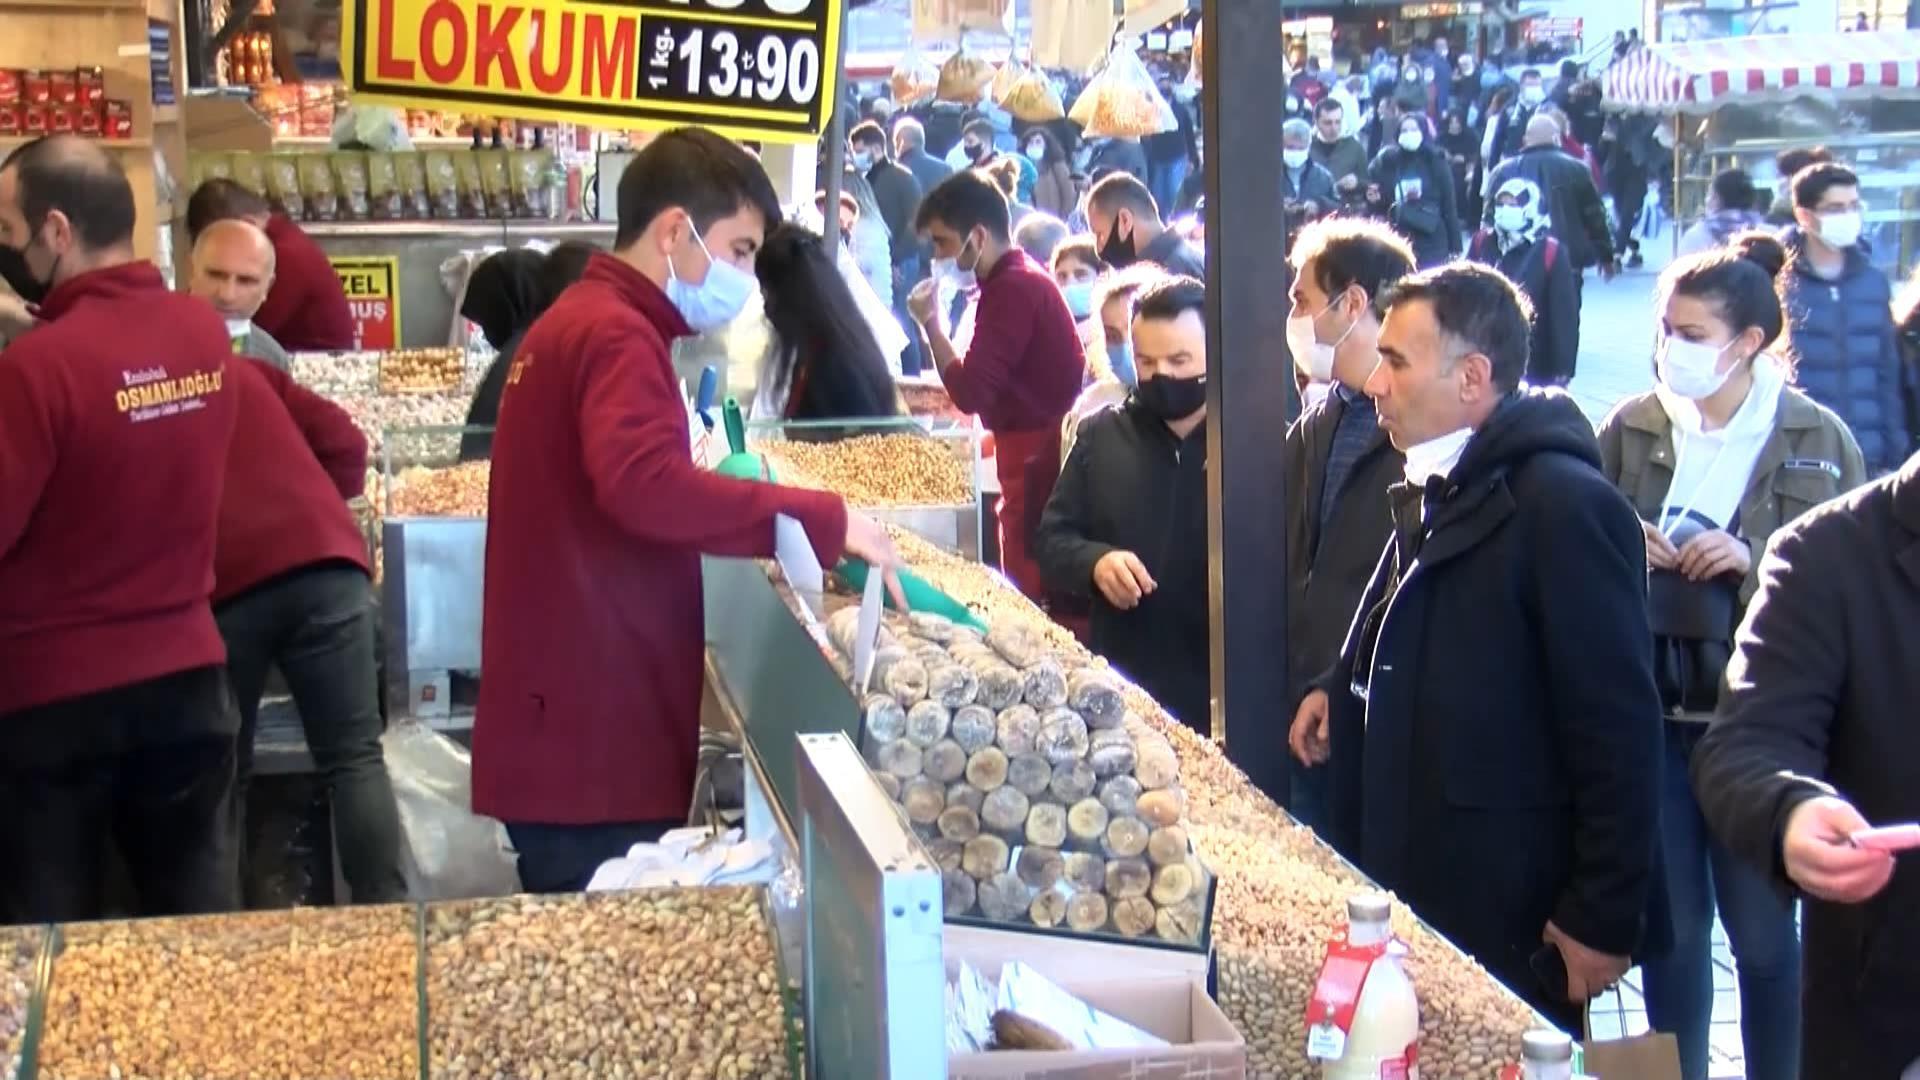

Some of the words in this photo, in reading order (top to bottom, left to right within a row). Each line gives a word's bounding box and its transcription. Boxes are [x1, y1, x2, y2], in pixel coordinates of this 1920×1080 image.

[378, 0, 637, 100] LOKUM
[340, 274, 381, 294] ZEL
[116, 369, 223, 412] OSMANLIOĞLU
